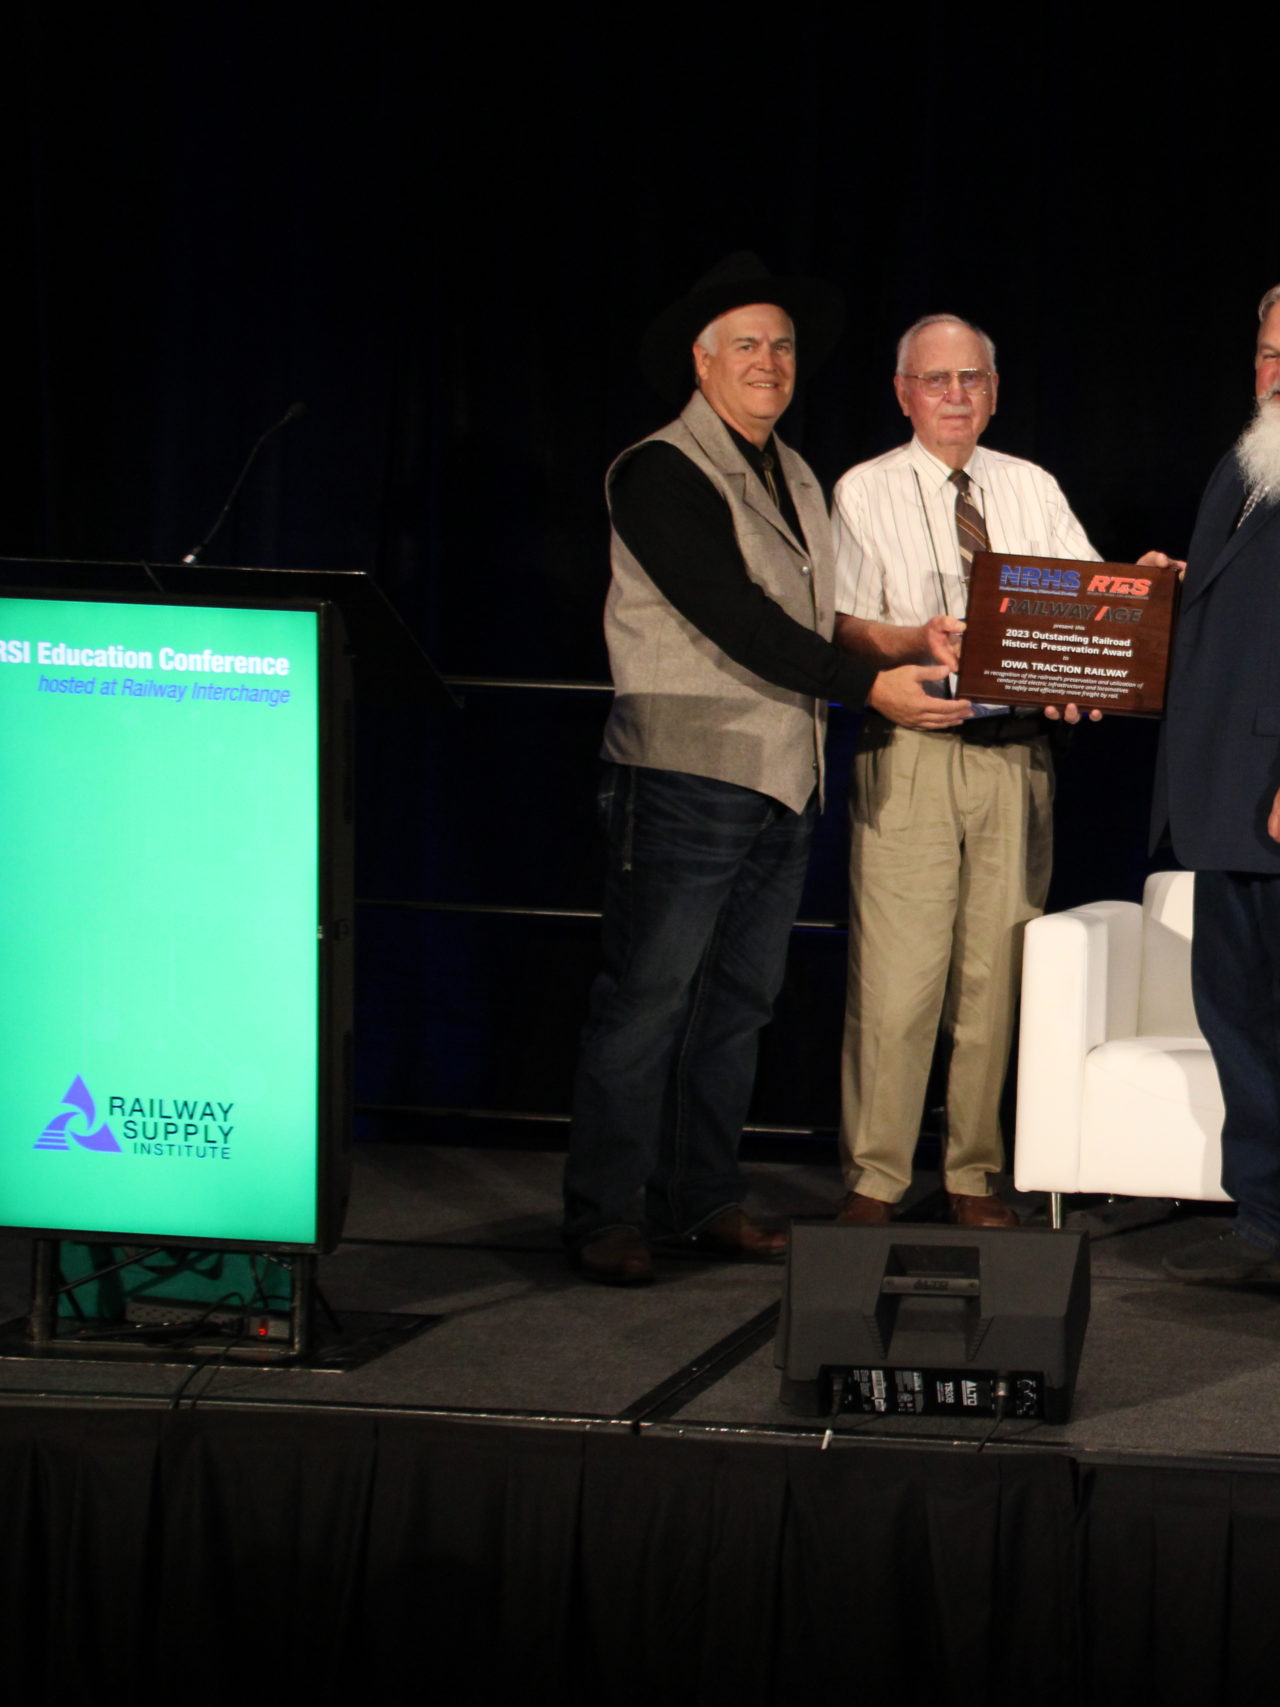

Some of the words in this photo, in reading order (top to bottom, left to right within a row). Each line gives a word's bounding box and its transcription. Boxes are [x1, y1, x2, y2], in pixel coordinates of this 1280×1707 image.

[1000, 565, 1081, 591] NRHS
[1000, 598, 1097, 620] RAILWAY
[1094, 606, 1143, 623] AGE
[1002, 639, 1038, 649] Historic
[1041, 642, 1099, 655] Preservation
[1102, 648, 1132, 657] Award
[1006, 629, 1029, 638] 2023
[1032, 631, 1089, 645] Outstanding
[1092, 636, 1130, 646] Railroad
[37, 641, 153, 669] Education
[159, 647, 289, 676] Conference
[1001, 660, 1028, 669] IOWA
[1031, 662, 1081, 674] TRACTION
[1084, 667, 1128, 677] RAILWAY
[37, 675, 96, 694] hosted
[100, 679, 118, 696] at
[121, 679, 188, 702] Railway
[192, 682, 291, 707] Interchange
[109, 1096, 235, 1122] RAILWAY
[122, 1120, 235, 1145] SUPPLY
[132, 1142, 232, 1160] INSTITUTE
[966, 1381, 978, 1406] ALTO
